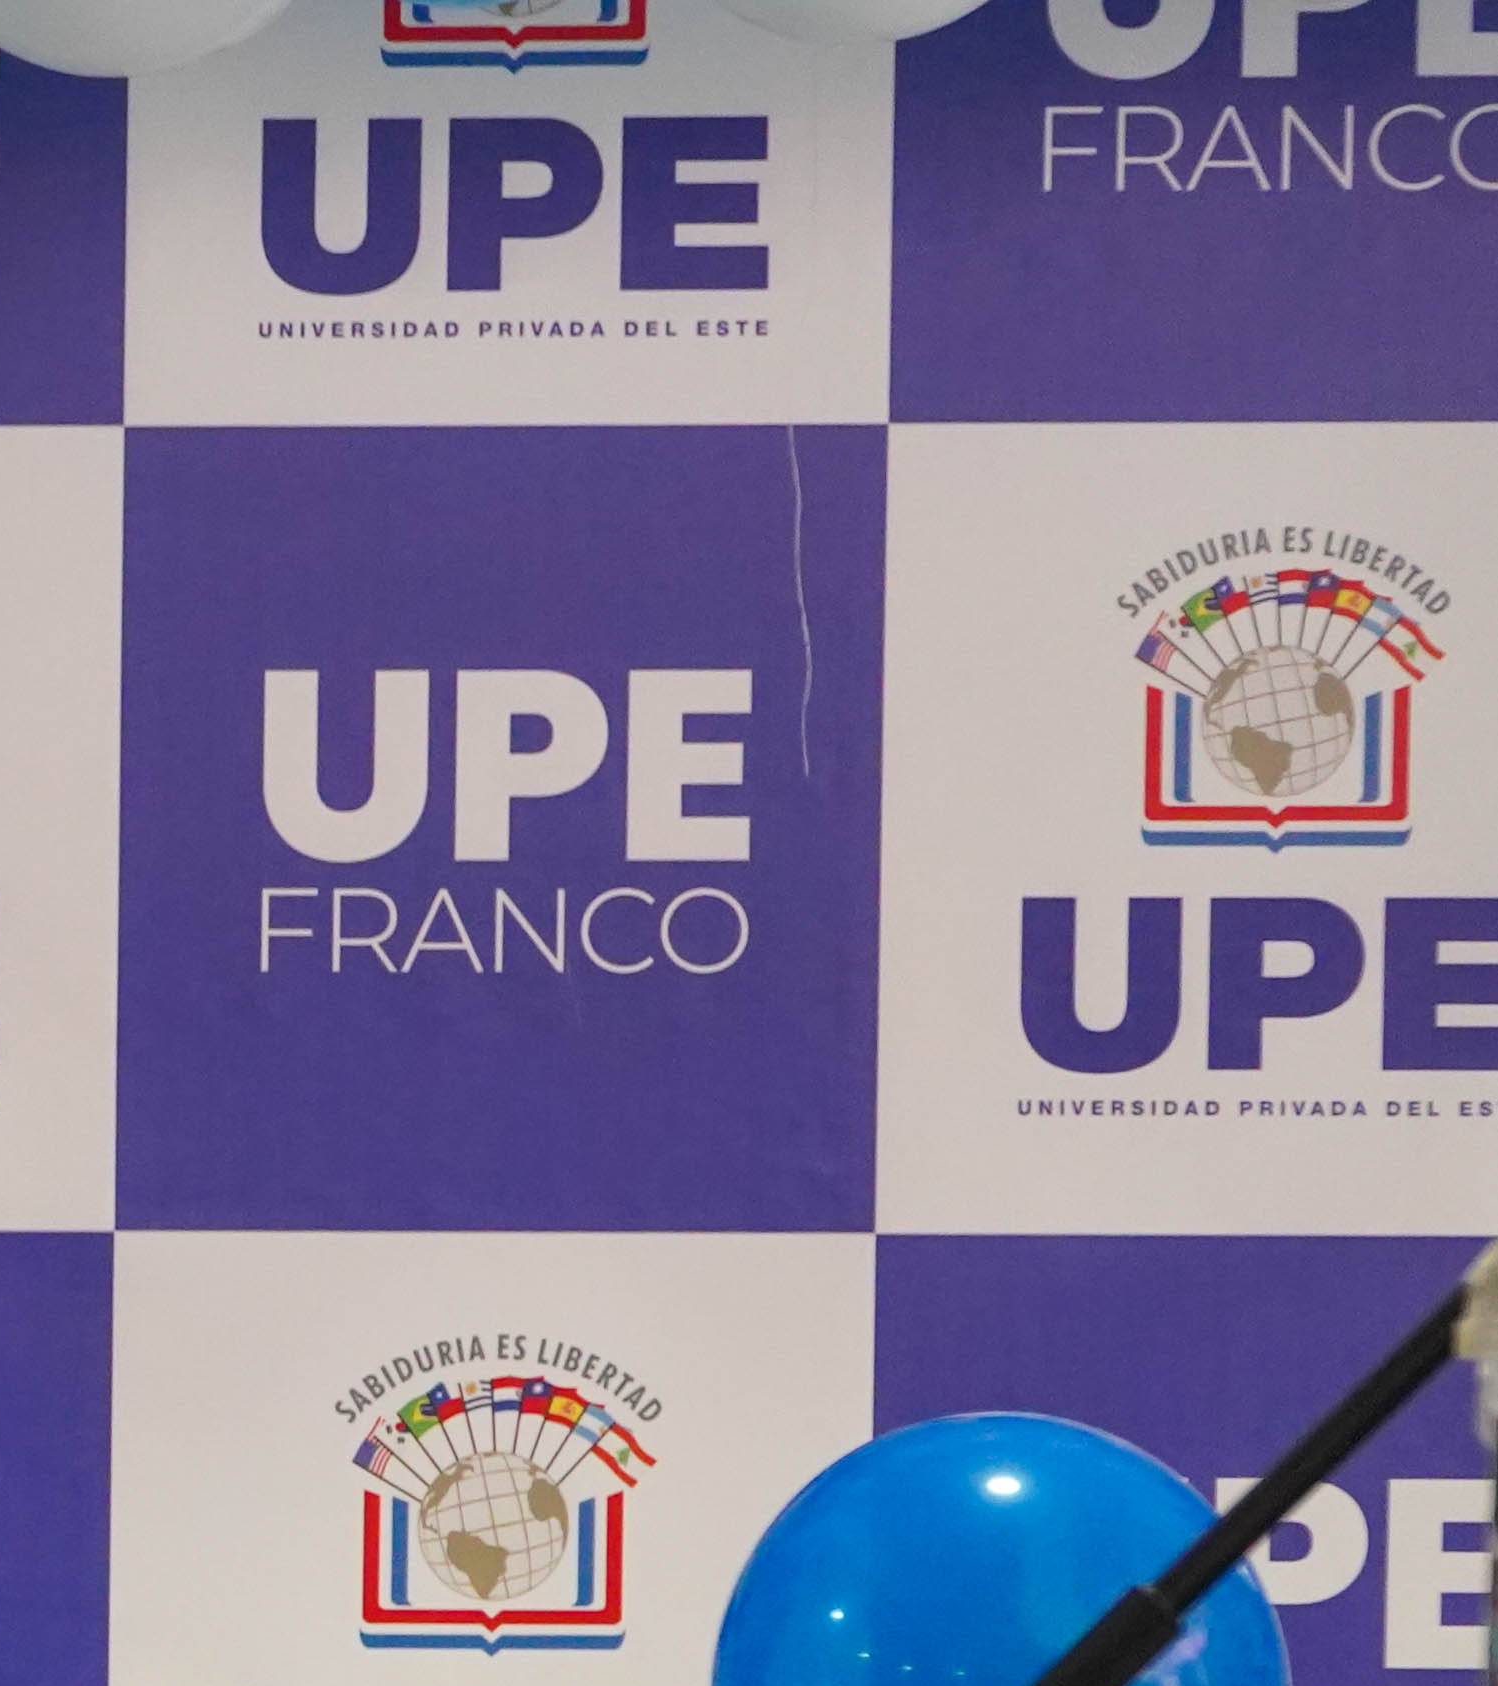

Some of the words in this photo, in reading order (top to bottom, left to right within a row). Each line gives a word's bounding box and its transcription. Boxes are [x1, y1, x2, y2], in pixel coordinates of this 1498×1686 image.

[261, 116, 769, 295] UPE
[259, 322, 460, 338] UNIVERSIDAD
[478, 321, 606, 338] PRIVADA
[624, 321, 679, 337] DEL
[697, 320, 770, 337] ESTE
[1117, 528, 1272, 617] SABIDURIA
[1282, 526, 1314, 554] ES
[1323, 530, 1452, 617] LIBERTAD
[263, 669, 752, 863] UPE
[259, 888, 750, 974] FRANCO
[1019, 896, 1498, 1074] UPE
[1018, 1100, 1221, 1117] UNIVERSIDAD
[1240, 1100, 1368, 1117] PRIVADA
[1387, 1101, 1440, 1117] DEL
[334, 1334, 487, 1425] SABIDURIA
[497, 1333, 528, 1361] ES
[537, 1337, 664, 1425] LIBERTAD
